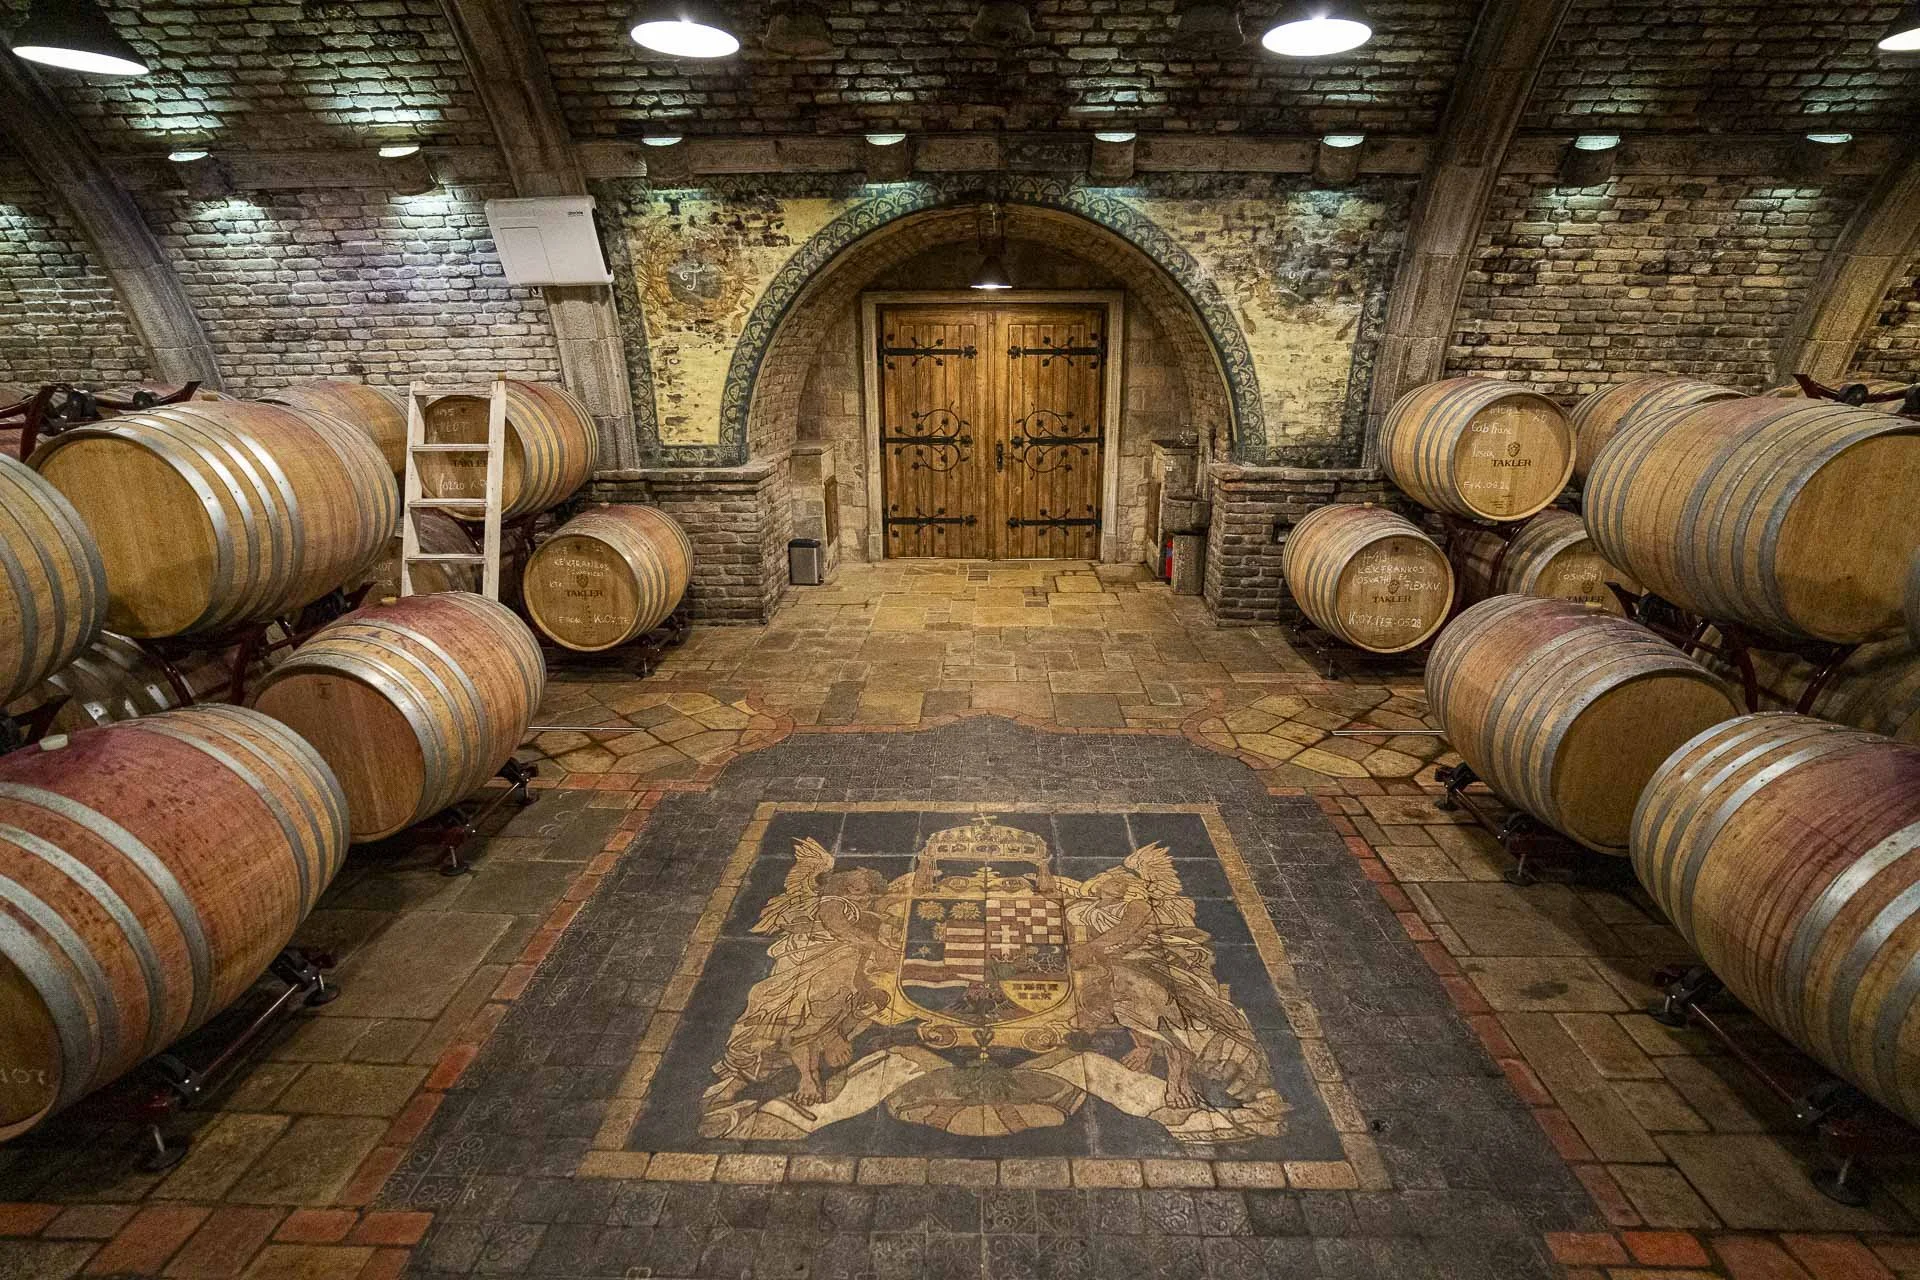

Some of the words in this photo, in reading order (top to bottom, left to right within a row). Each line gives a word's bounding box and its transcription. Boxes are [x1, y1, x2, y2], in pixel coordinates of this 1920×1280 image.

[1491, 459, 1531, 468] TAKLER
[566, 588, 603, 598] TAKLER
[1372, 594, 1412, 603] TAKLER
